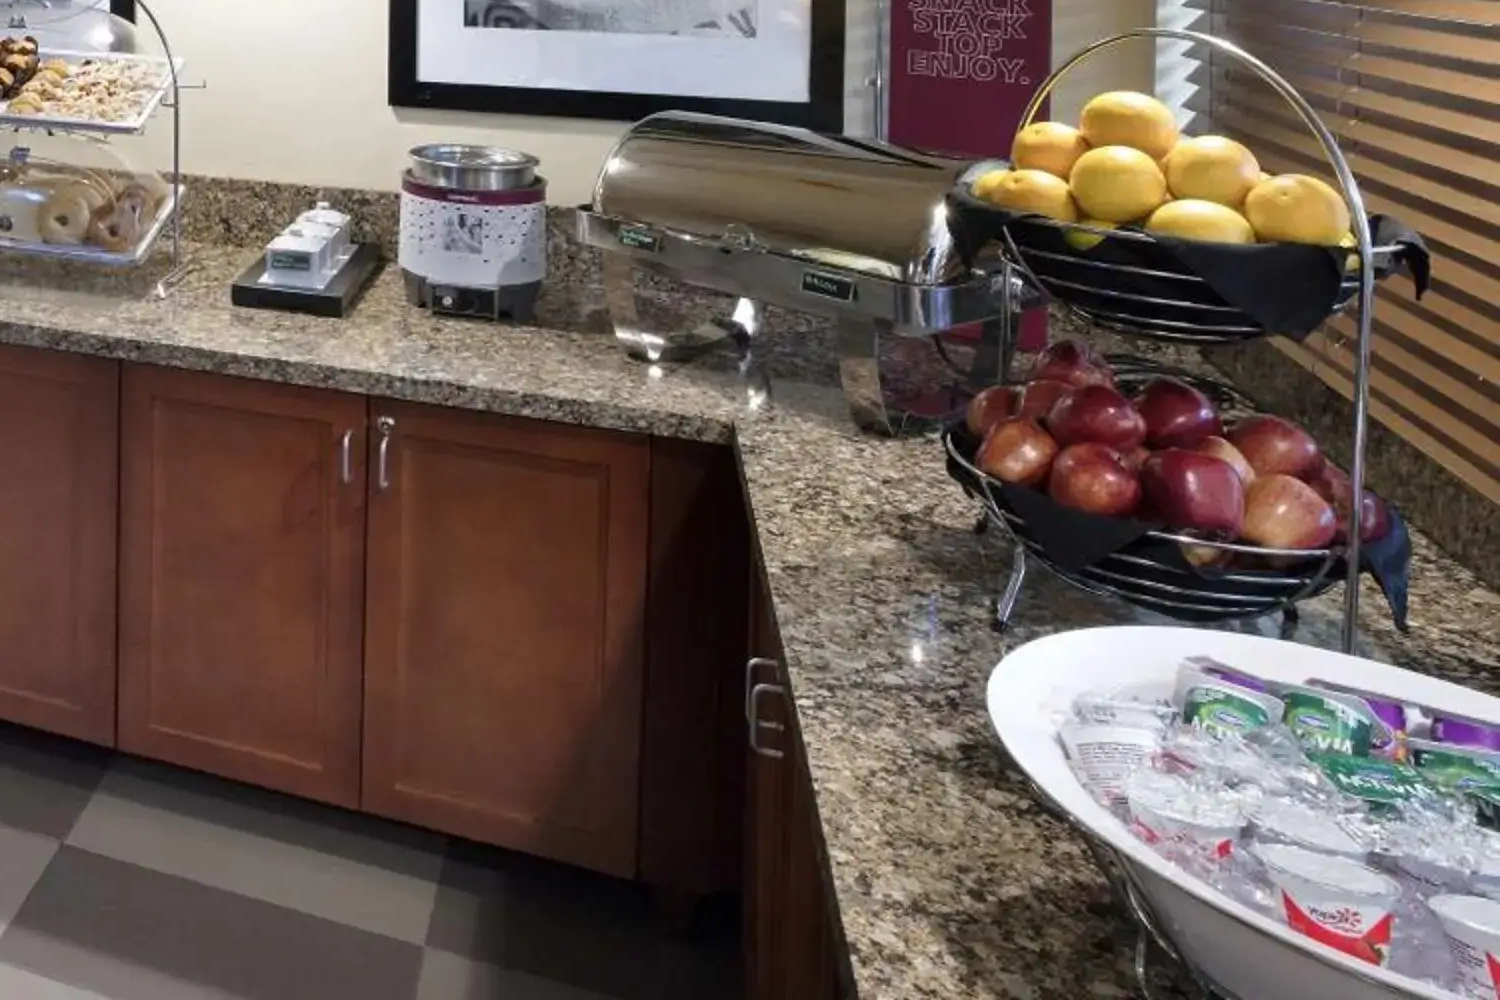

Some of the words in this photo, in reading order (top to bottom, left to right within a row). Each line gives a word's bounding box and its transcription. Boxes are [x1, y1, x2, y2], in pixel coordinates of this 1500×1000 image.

[913, 9, 1028, 39] STACK
[933, 30, 1003, 57] TOP
[907, 49, 1030, 85] ENJOY.
